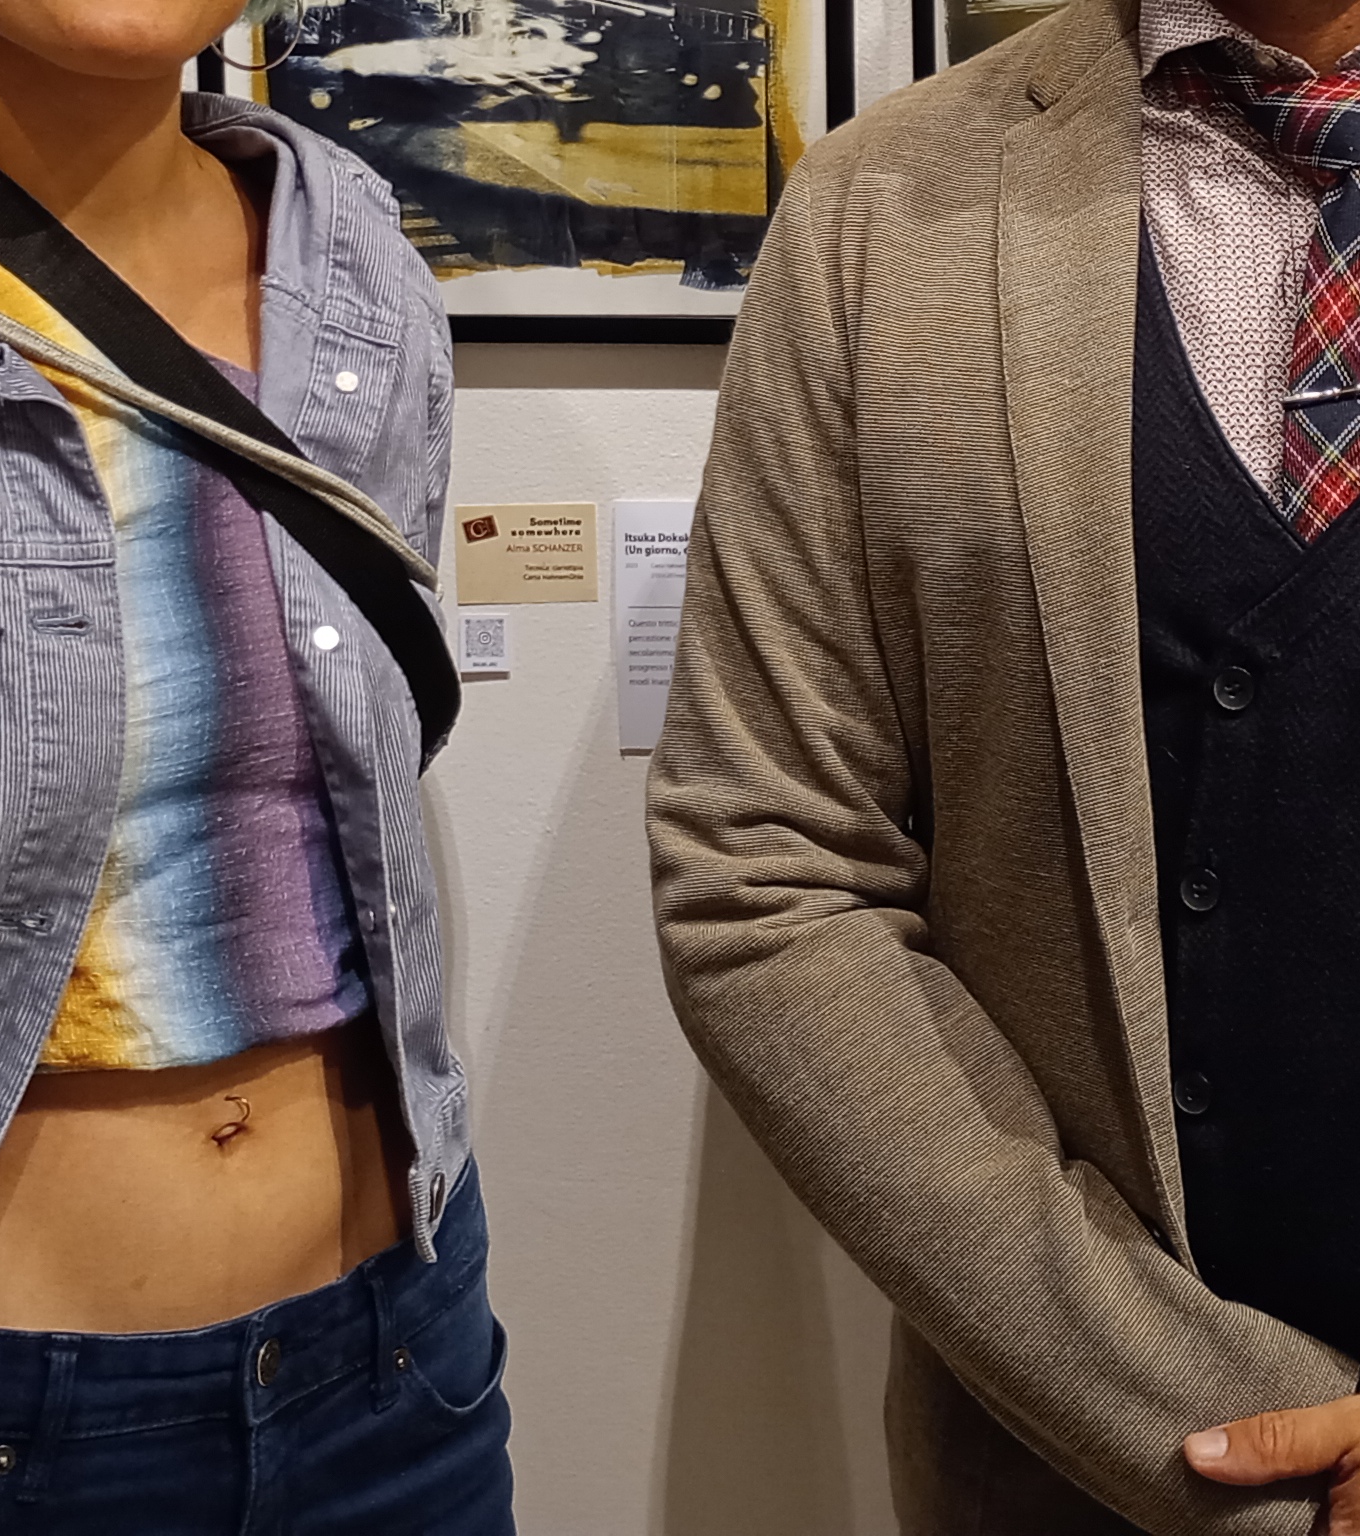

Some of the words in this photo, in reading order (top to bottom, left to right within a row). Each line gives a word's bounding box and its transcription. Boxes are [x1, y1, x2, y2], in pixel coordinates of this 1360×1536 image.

[530, 518, 582, 526] Sometime
[511, 528, 581, 536] somewhere
[625, 533, 655, 542] Itsuka
[658, 533, 689, 542] Dokok
[506, 544, 530, 552] Alma
[533, 544, 582, 552] SCHANZER
[625, 545, 642, 555] (Un
[645, 546, 681, 557] giorno,
